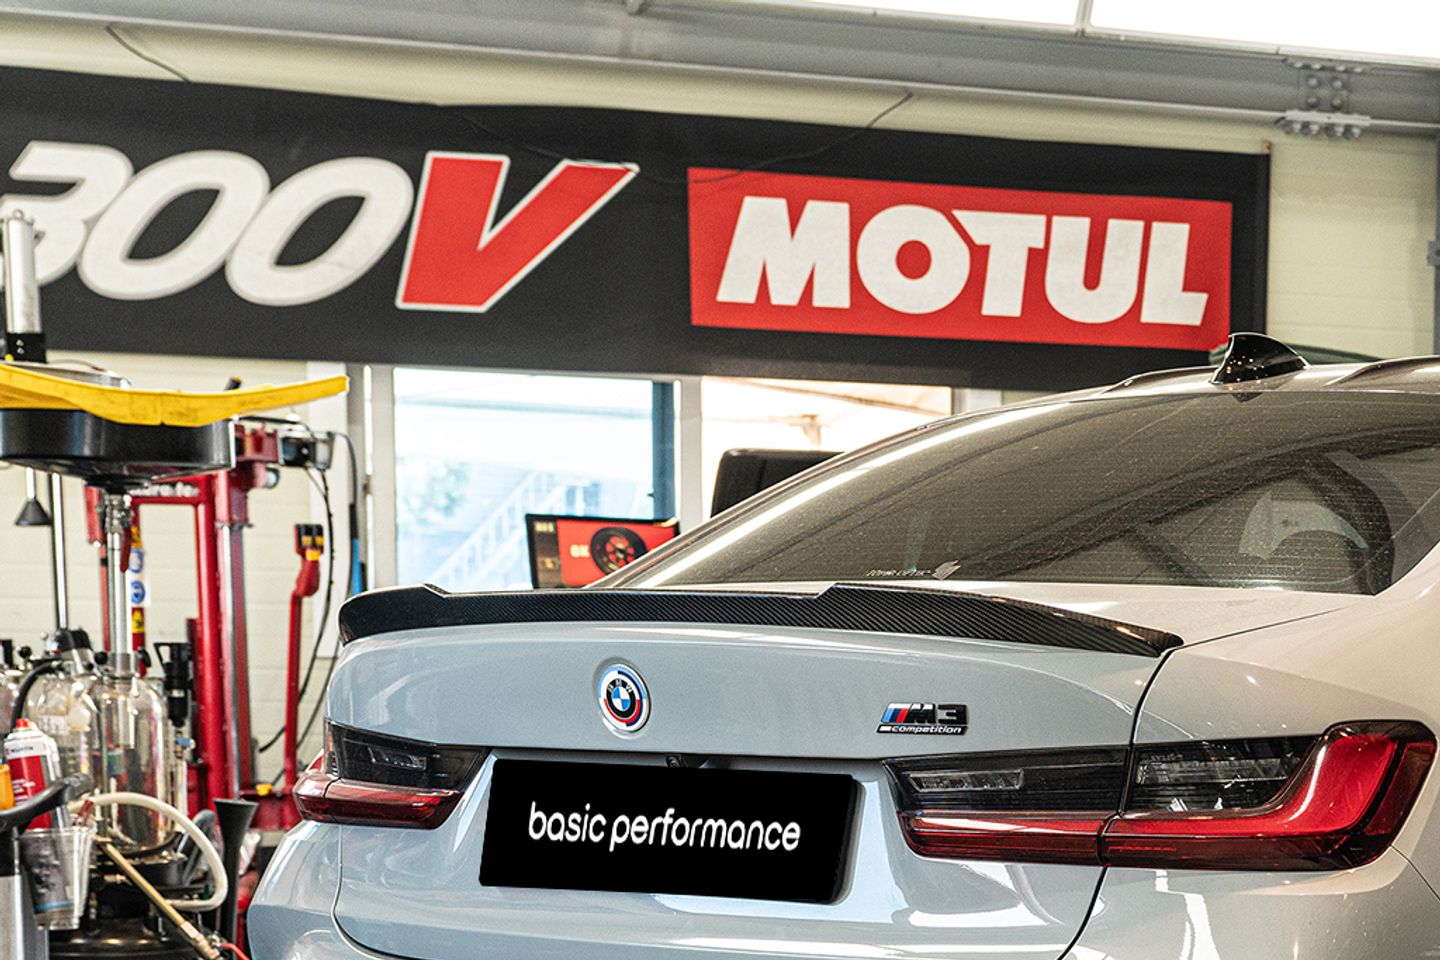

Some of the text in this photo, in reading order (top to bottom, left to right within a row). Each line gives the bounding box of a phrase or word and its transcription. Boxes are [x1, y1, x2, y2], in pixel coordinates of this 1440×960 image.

[0, 140, 640, 312] 300V
[716, 196, 1209, 326] MOTUL
[891, 725, 962, 734] competition
[903, 703, 968, 724] M3
